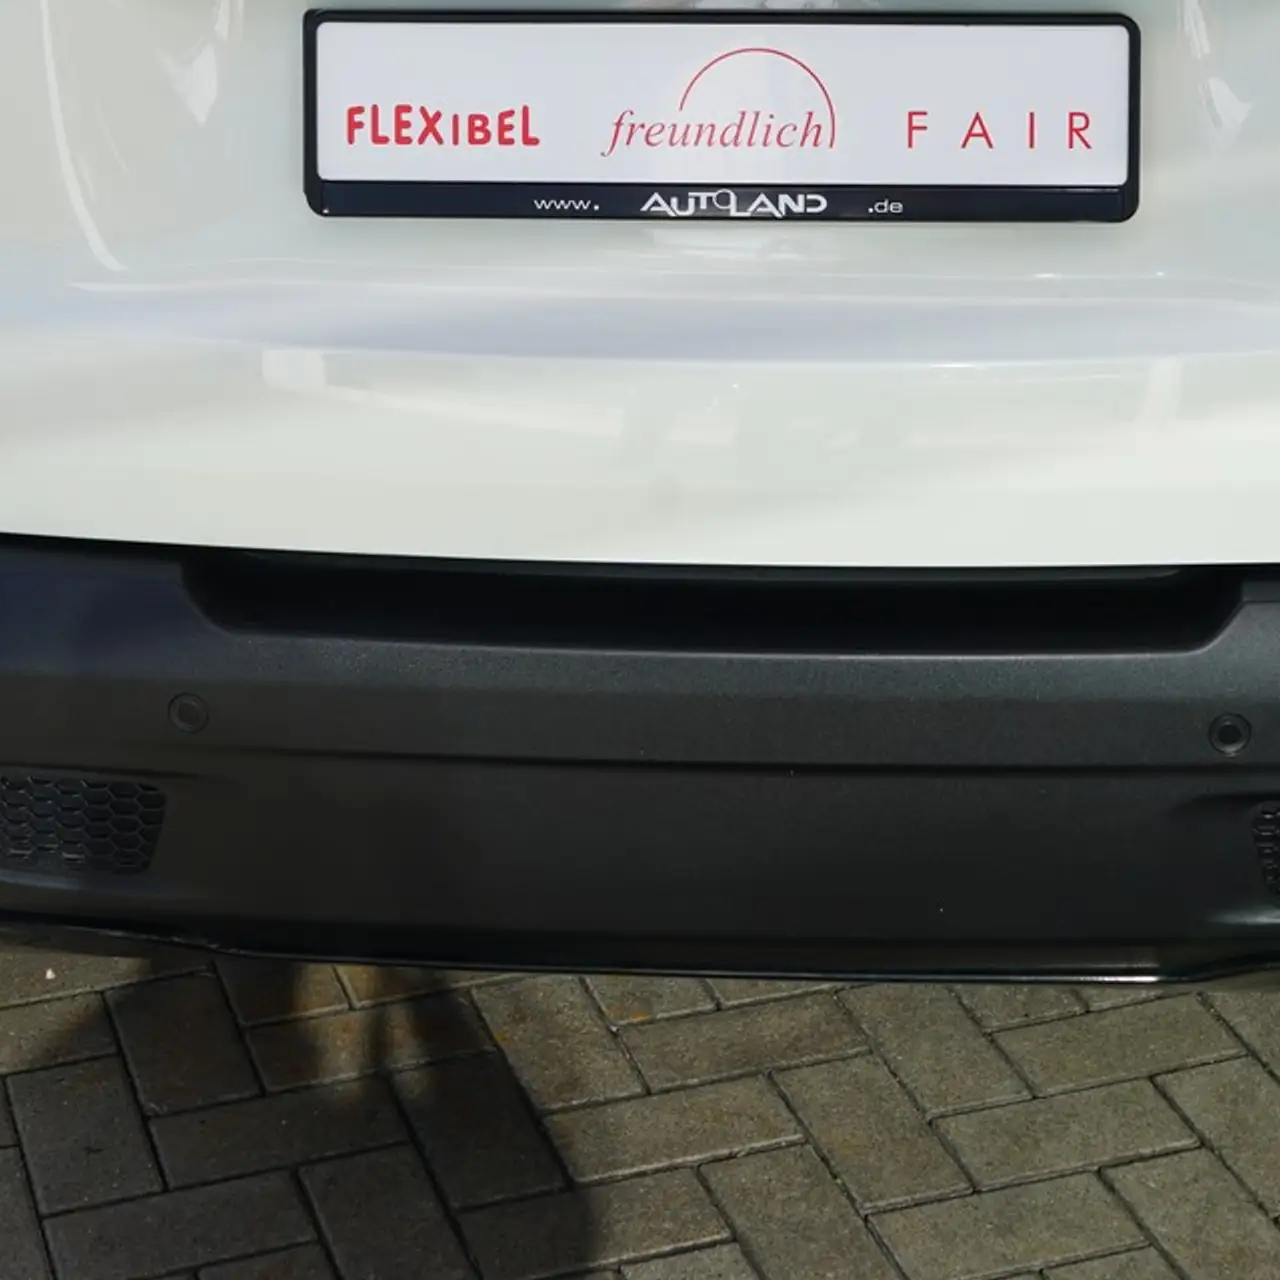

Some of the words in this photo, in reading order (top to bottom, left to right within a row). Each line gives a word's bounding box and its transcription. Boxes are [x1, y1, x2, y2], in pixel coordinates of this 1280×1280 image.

[346, 104, 540, 146] FLEXIBEL
[600, 109, 823, 157] freundlich
[907, 111, 1093, 149] FAIR
[533, 197, 600, 211] www.
[640, 189, 828, 218] AUTOLAND
[868, 199, 904, 214] .de
